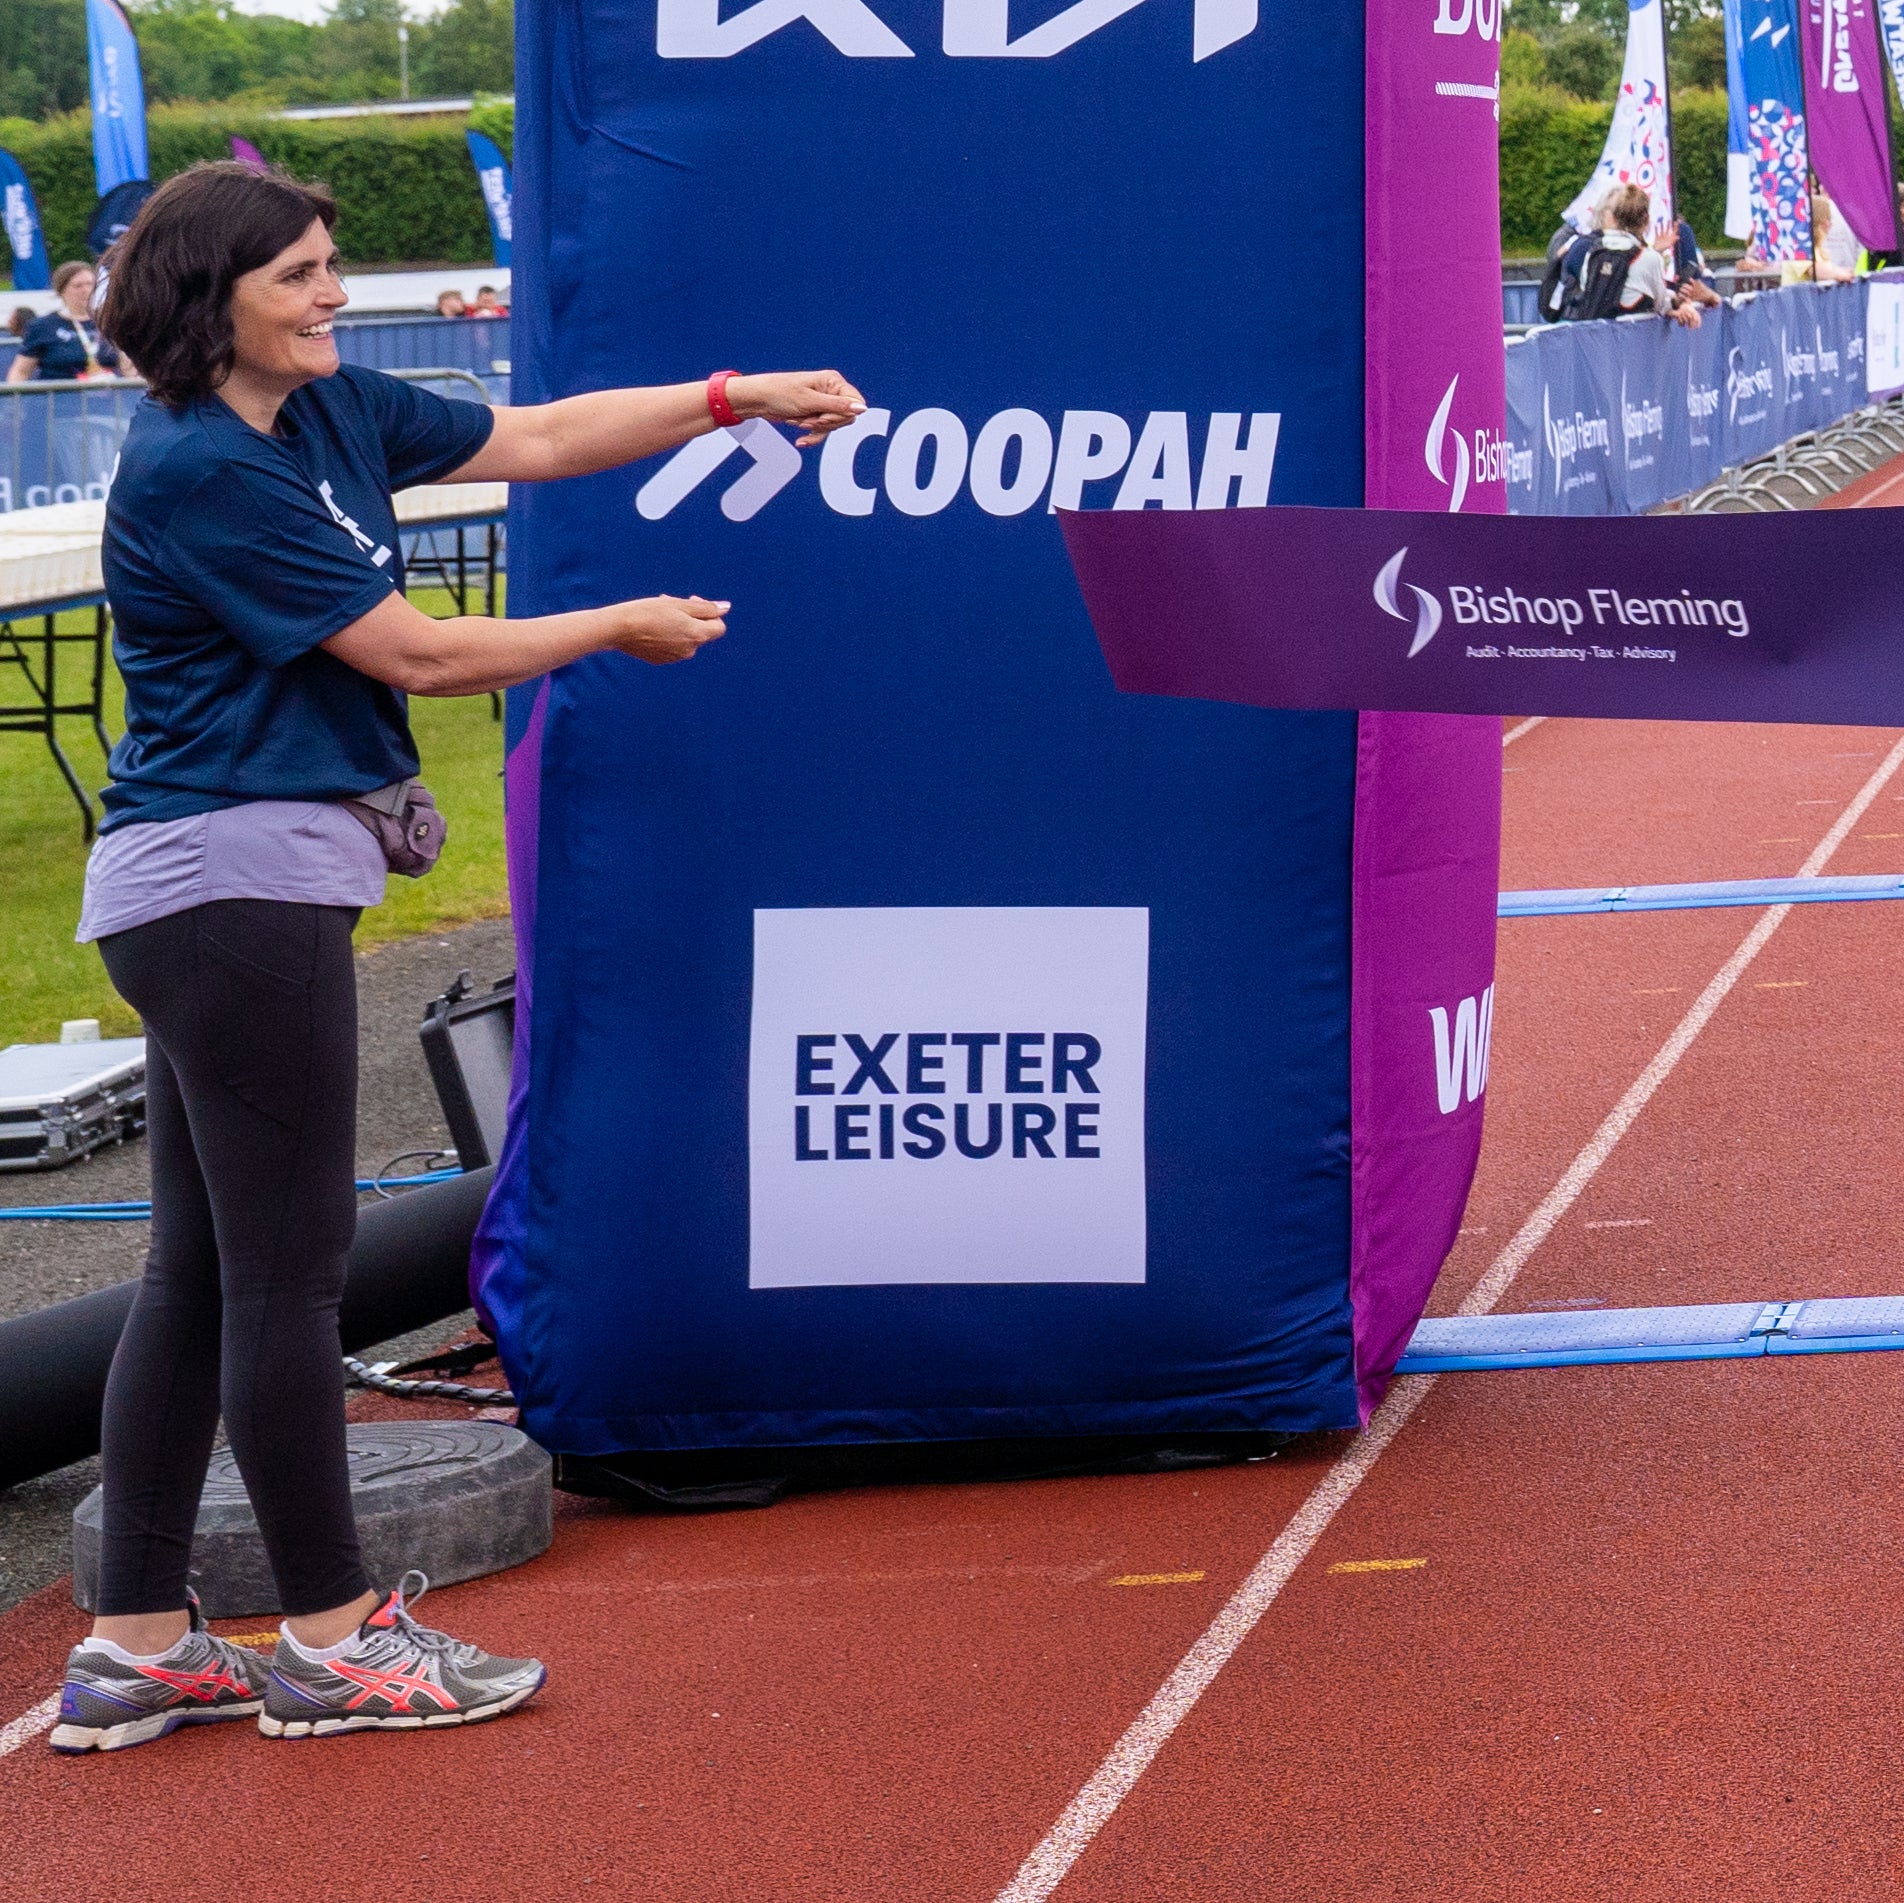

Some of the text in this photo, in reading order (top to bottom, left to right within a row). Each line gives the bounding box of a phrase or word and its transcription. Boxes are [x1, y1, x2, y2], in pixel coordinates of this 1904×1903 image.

[820, 407, 1282, 518] COOPAH
[1449, 586, 1749, 637] Bishop Fleming
[1466, 645, 1676, 663] Audit Accountancy Tax Advisory
[796, 1033, 1101, 1095] EXETER
[795, 1103, 1100, 1161] LEISURE
